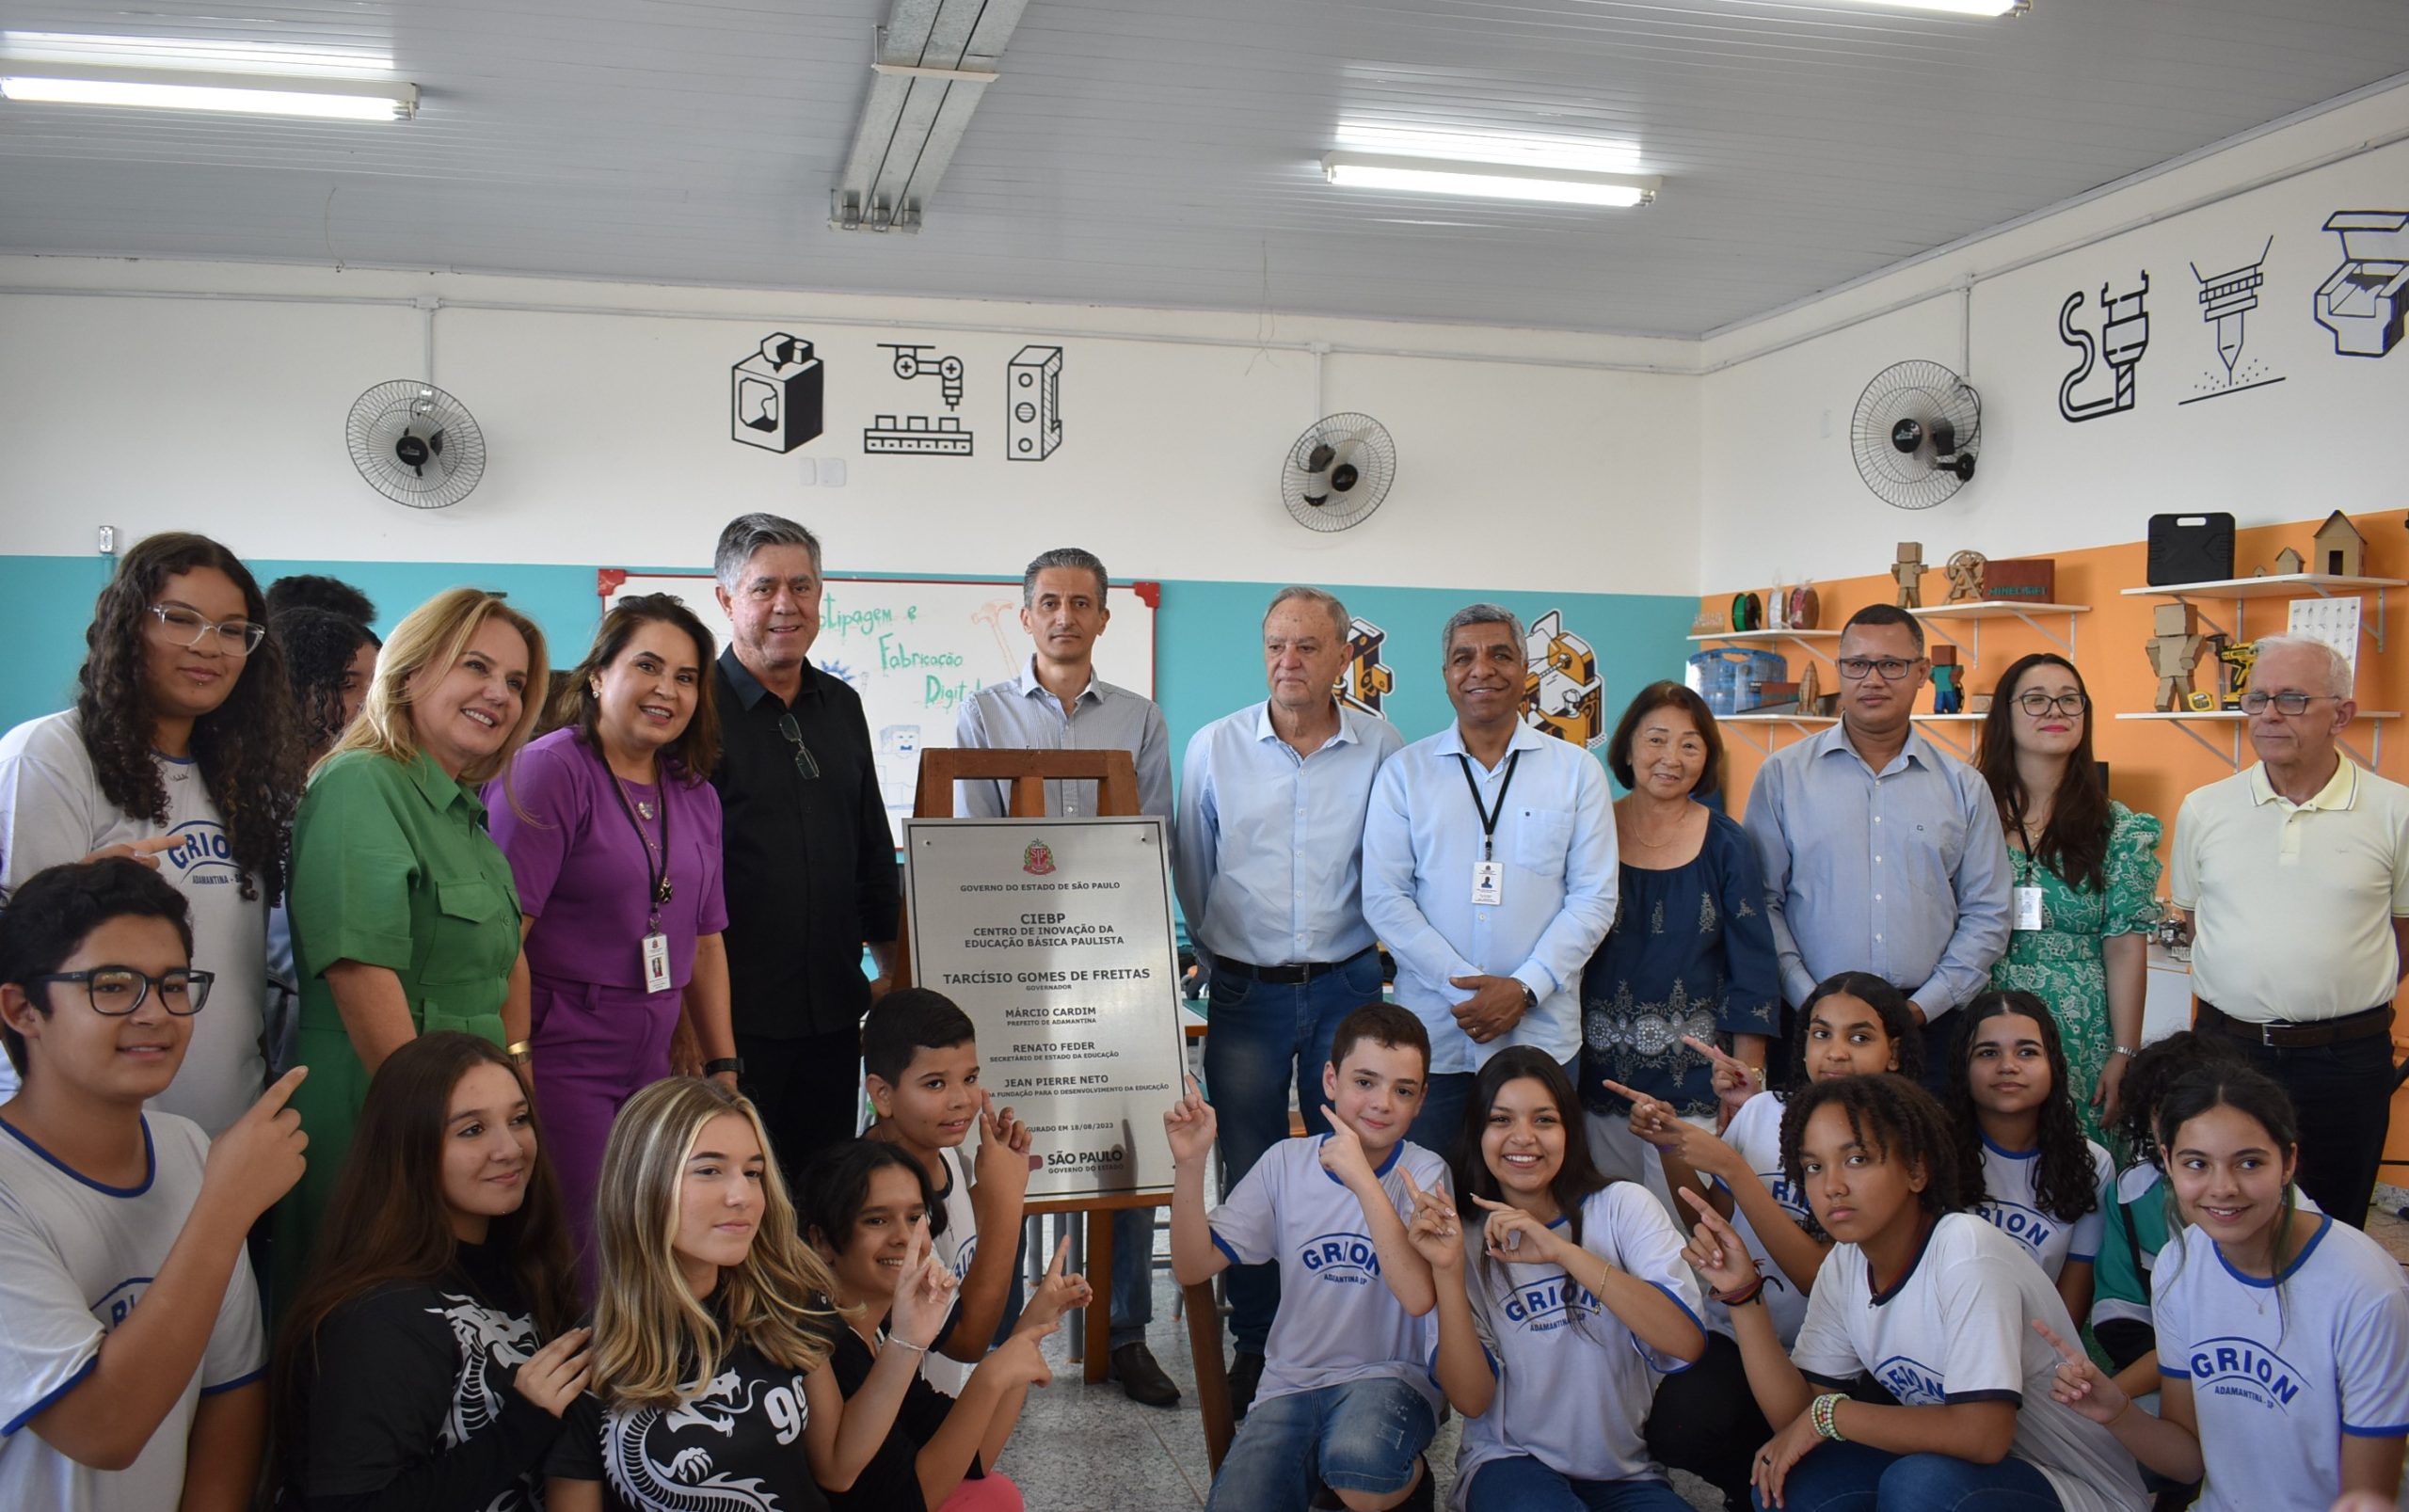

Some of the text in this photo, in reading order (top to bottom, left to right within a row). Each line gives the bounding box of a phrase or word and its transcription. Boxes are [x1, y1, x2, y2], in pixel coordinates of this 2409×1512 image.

[907, 605, 917, 620] e
[878, 632, 964, 670] Fabricação
[925, 674, 981, 708] Digitl
[168, 833, 231, 869] GRIO
[1006, 883, 1019, 892] DO
[1021, 883, 1055, 891] ESTADO
[1071, 881, 1090, 890] SÃO
[1020, 913, 1066, 925] CIEBP
[973, 923, 1114, 936] CENTRO DE INOVAÇÃO DA
[965, 936, 1125, 949] EDUCAÇÃO BÁSICA PAULISTA
[943, 968, 1151, 984] TARCÍSIO GOMES DE FREITAS
[1005, 1006, 1096, 1018] MÁRCIO CARDIM
[1013, 1041, 1095, 1053] RENATO FEDER
[989, 1053, 1032, 1062] SECRETÁRIO
[1083, 1050, 1120, 1058] EDUCAÇÃO
[1004, 1074, 1109, 1088] JEAN PIERRE NETO
[997, 1090, 1033, 1099] FUNDAÇÃO
[1135, 1082, 1170, 1091] EDUCAÇÃO
[1047, 1149, 1123, 1166] SÃO PAULO
[1047, 1166, 1083, 1174] GOVERNO
[1097, 1163, 1124, 1171] ESTADO
[2191, 1347, 2299, 1405] GRION
[2214, 1386, 2263, 1403] ADAMANTINA
